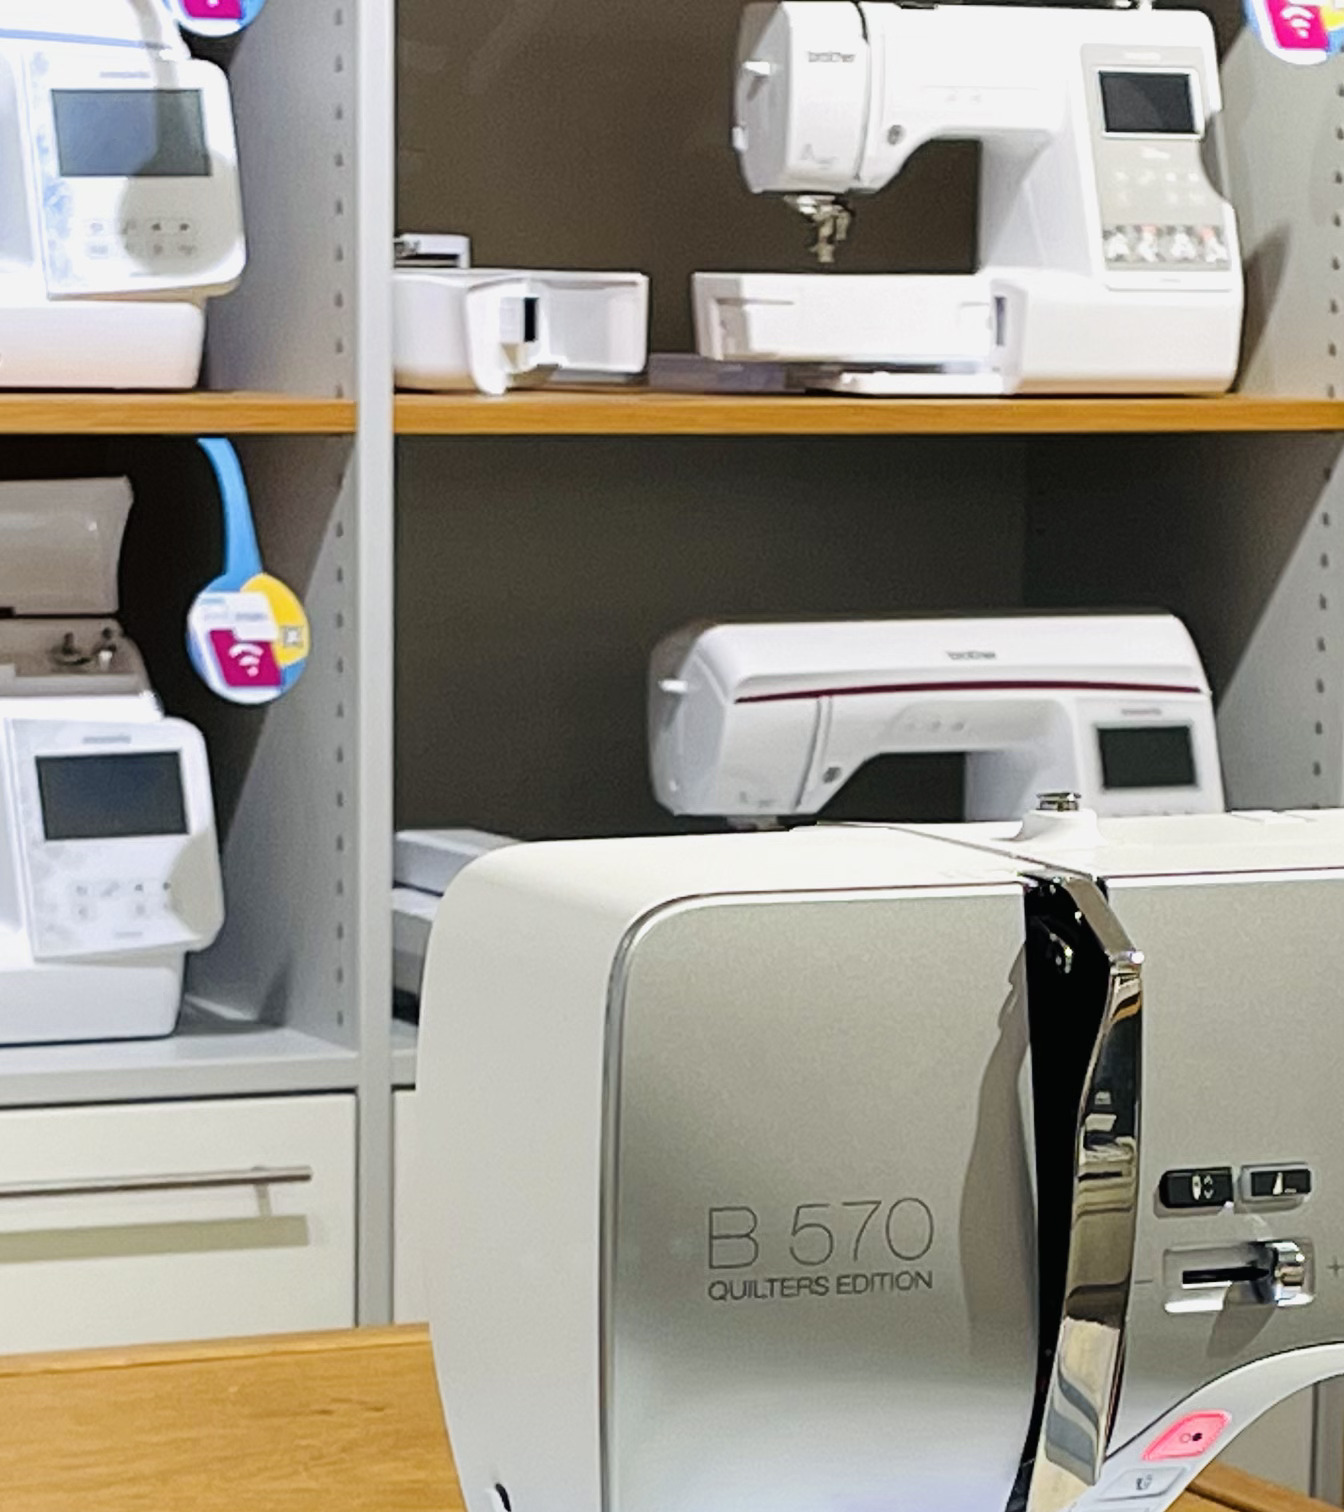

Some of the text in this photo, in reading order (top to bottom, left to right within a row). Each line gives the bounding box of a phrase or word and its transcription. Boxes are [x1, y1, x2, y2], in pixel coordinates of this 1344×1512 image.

[709, 1197, 934, 1270] B 570
[708, 1270, 933, 1301] QUILTERS EDITION
